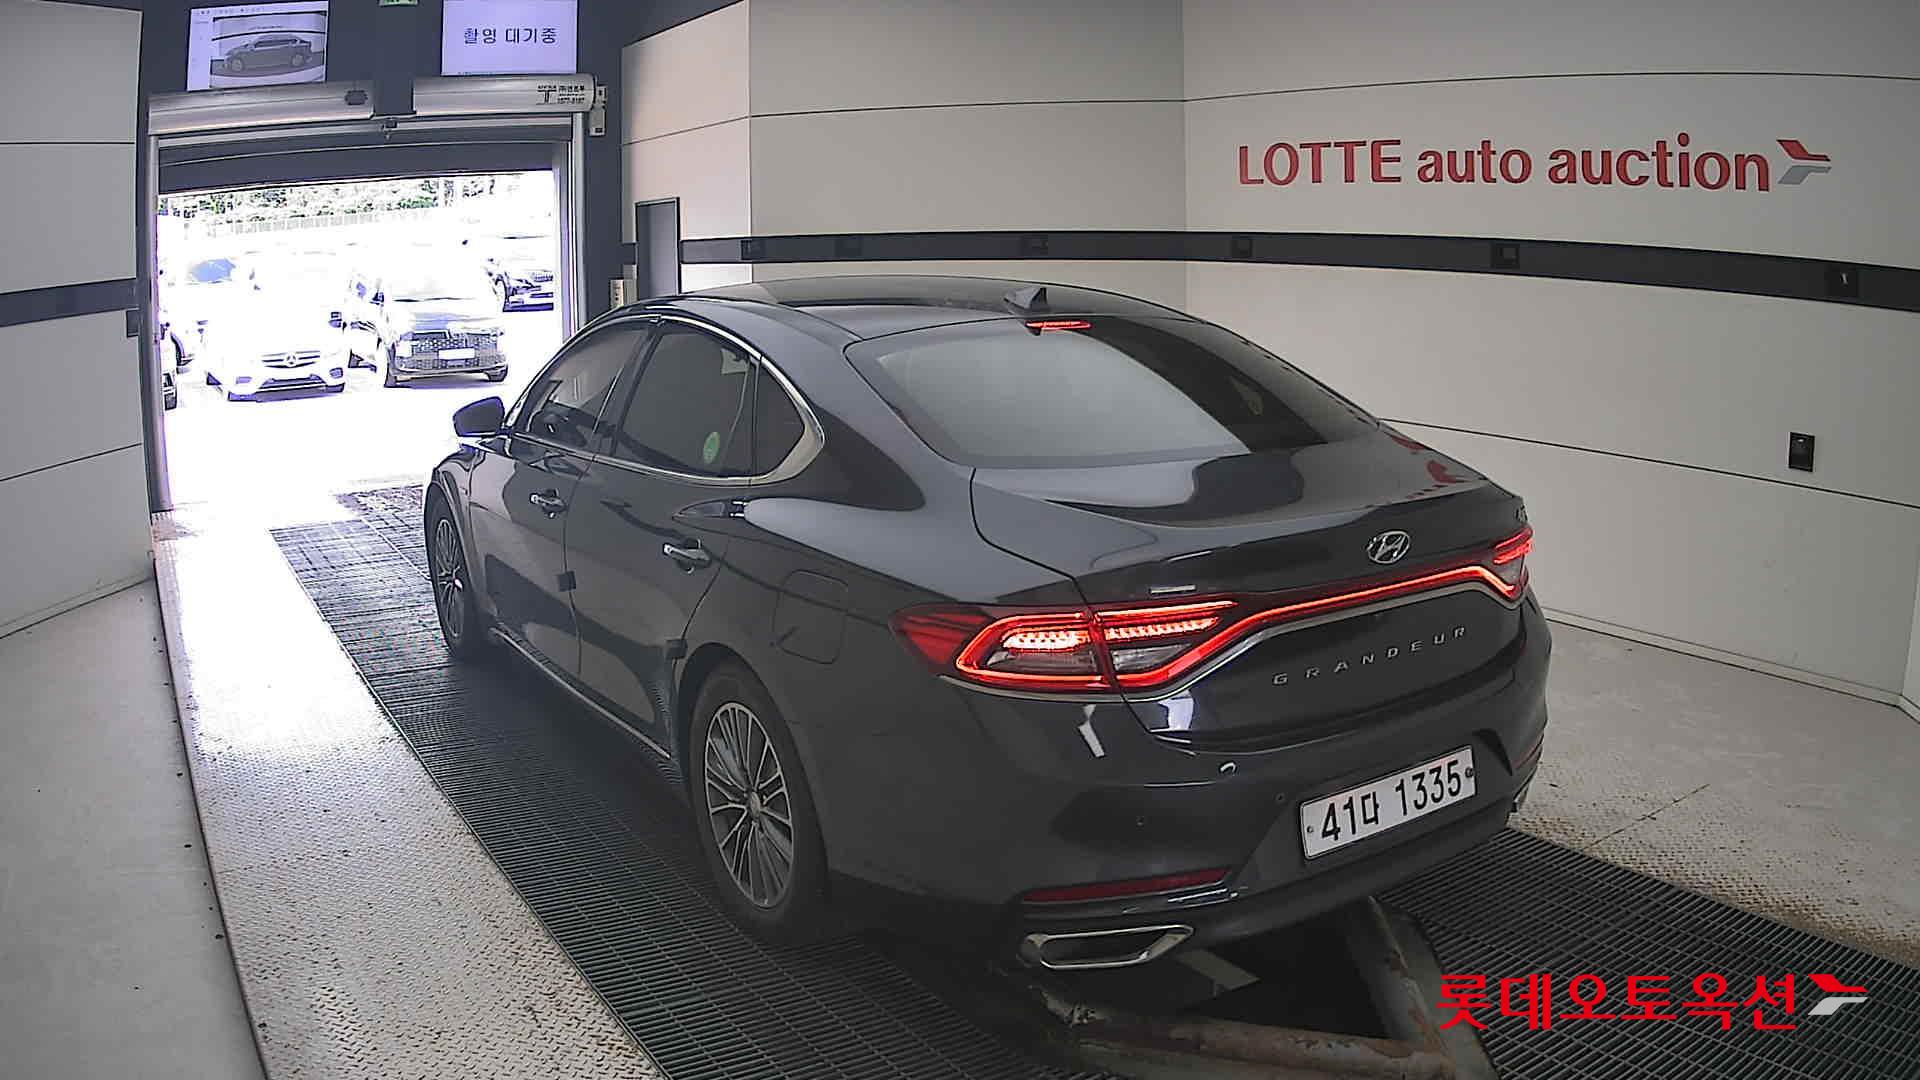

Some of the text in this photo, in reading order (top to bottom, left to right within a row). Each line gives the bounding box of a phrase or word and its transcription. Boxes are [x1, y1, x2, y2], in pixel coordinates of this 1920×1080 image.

[505, 28, 557, 44] 대기중
[1239, 132, 1770, 192] LOTTE auto auction
[1273, 627, 1466, 685] GRANDEUR
[1321, 759, 1462, 841] 41마 1335
